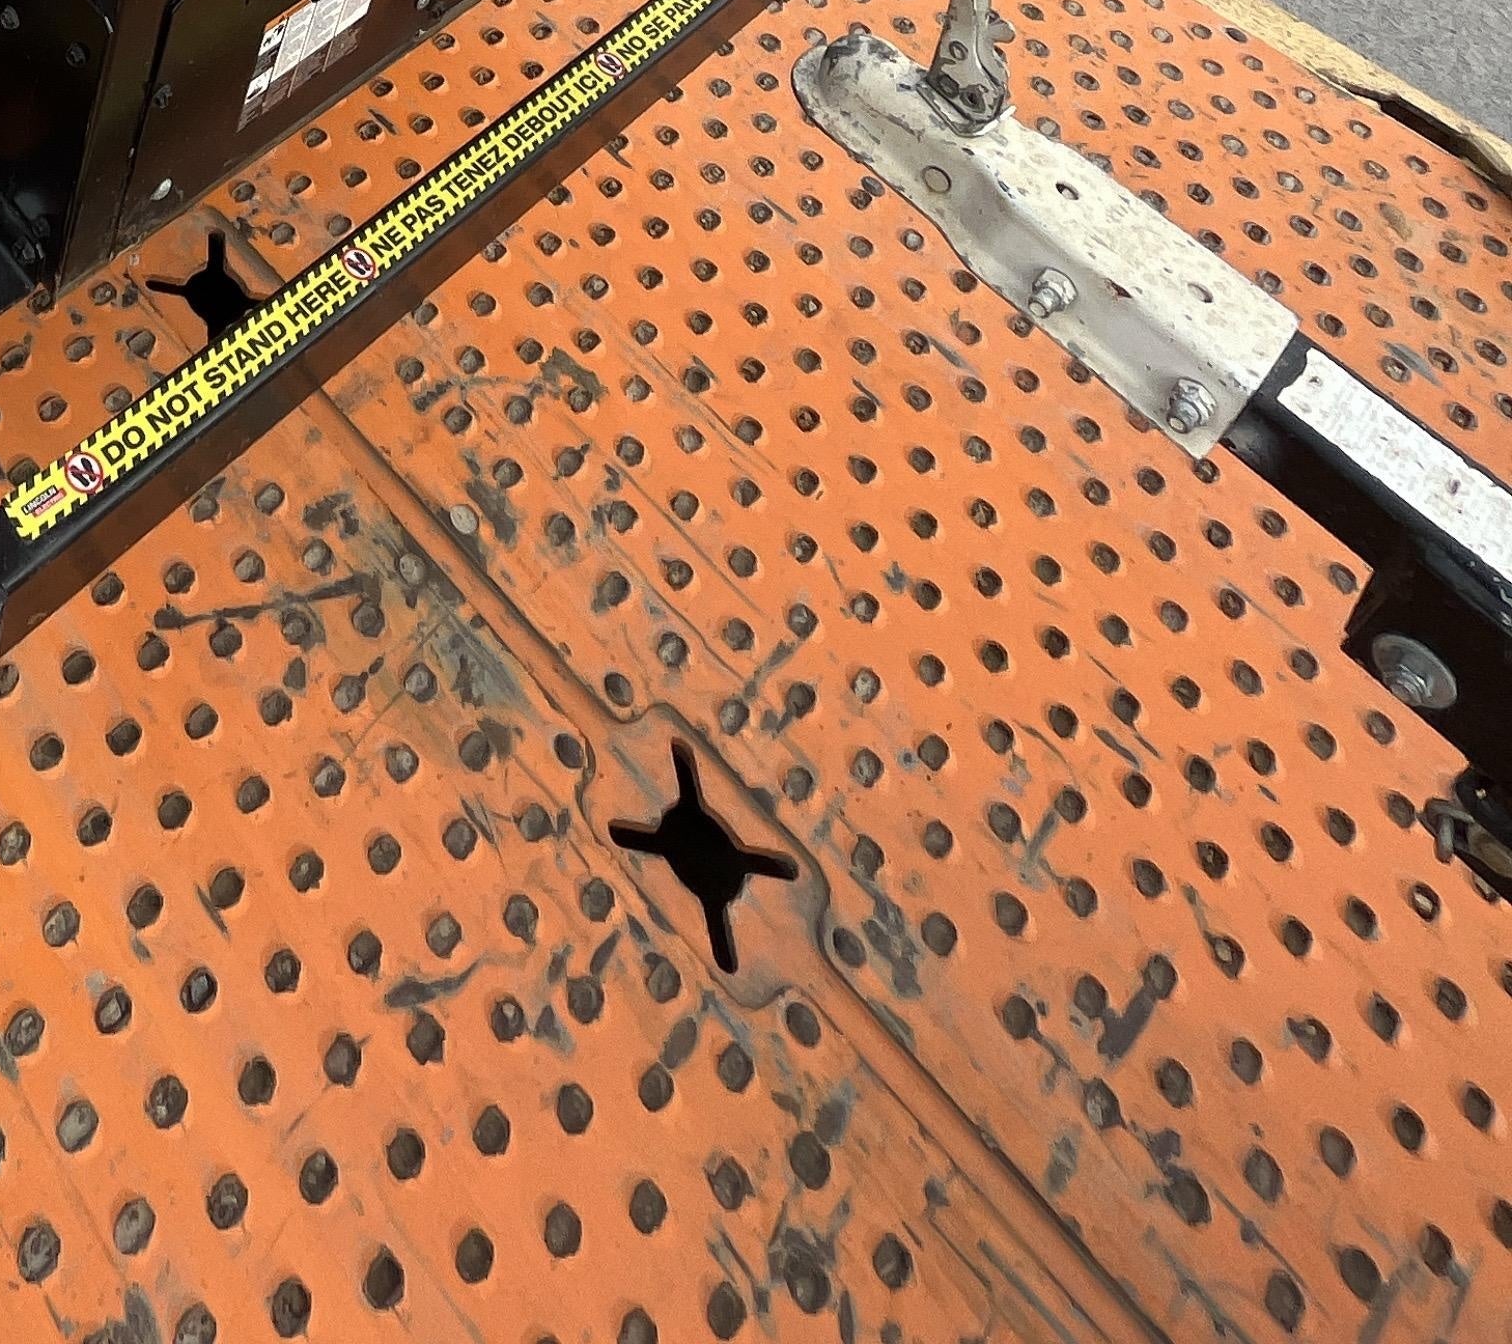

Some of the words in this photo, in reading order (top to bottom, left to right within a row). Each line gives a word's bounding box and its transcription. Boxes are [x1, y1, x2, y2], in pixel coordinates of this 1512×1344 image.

[101, 425, 145, 466] DO
[145, 380, 204, 433] NOT
[203, 319, 288, 389] STAND
[284, 269, 351, 327] HERE
[369, 225, 405, 258] NE
[400, 193, 446, 234] PAS
[440, 147, 508, 199] TENEZ
[501, 90, 577, 152] DEBOUT
[573, 70, 604, 95] ICI
[616, 34, 646, 61] NO
[641, 15, 670, 40] SE
[23, 486, 58, 514] LINCOLN
